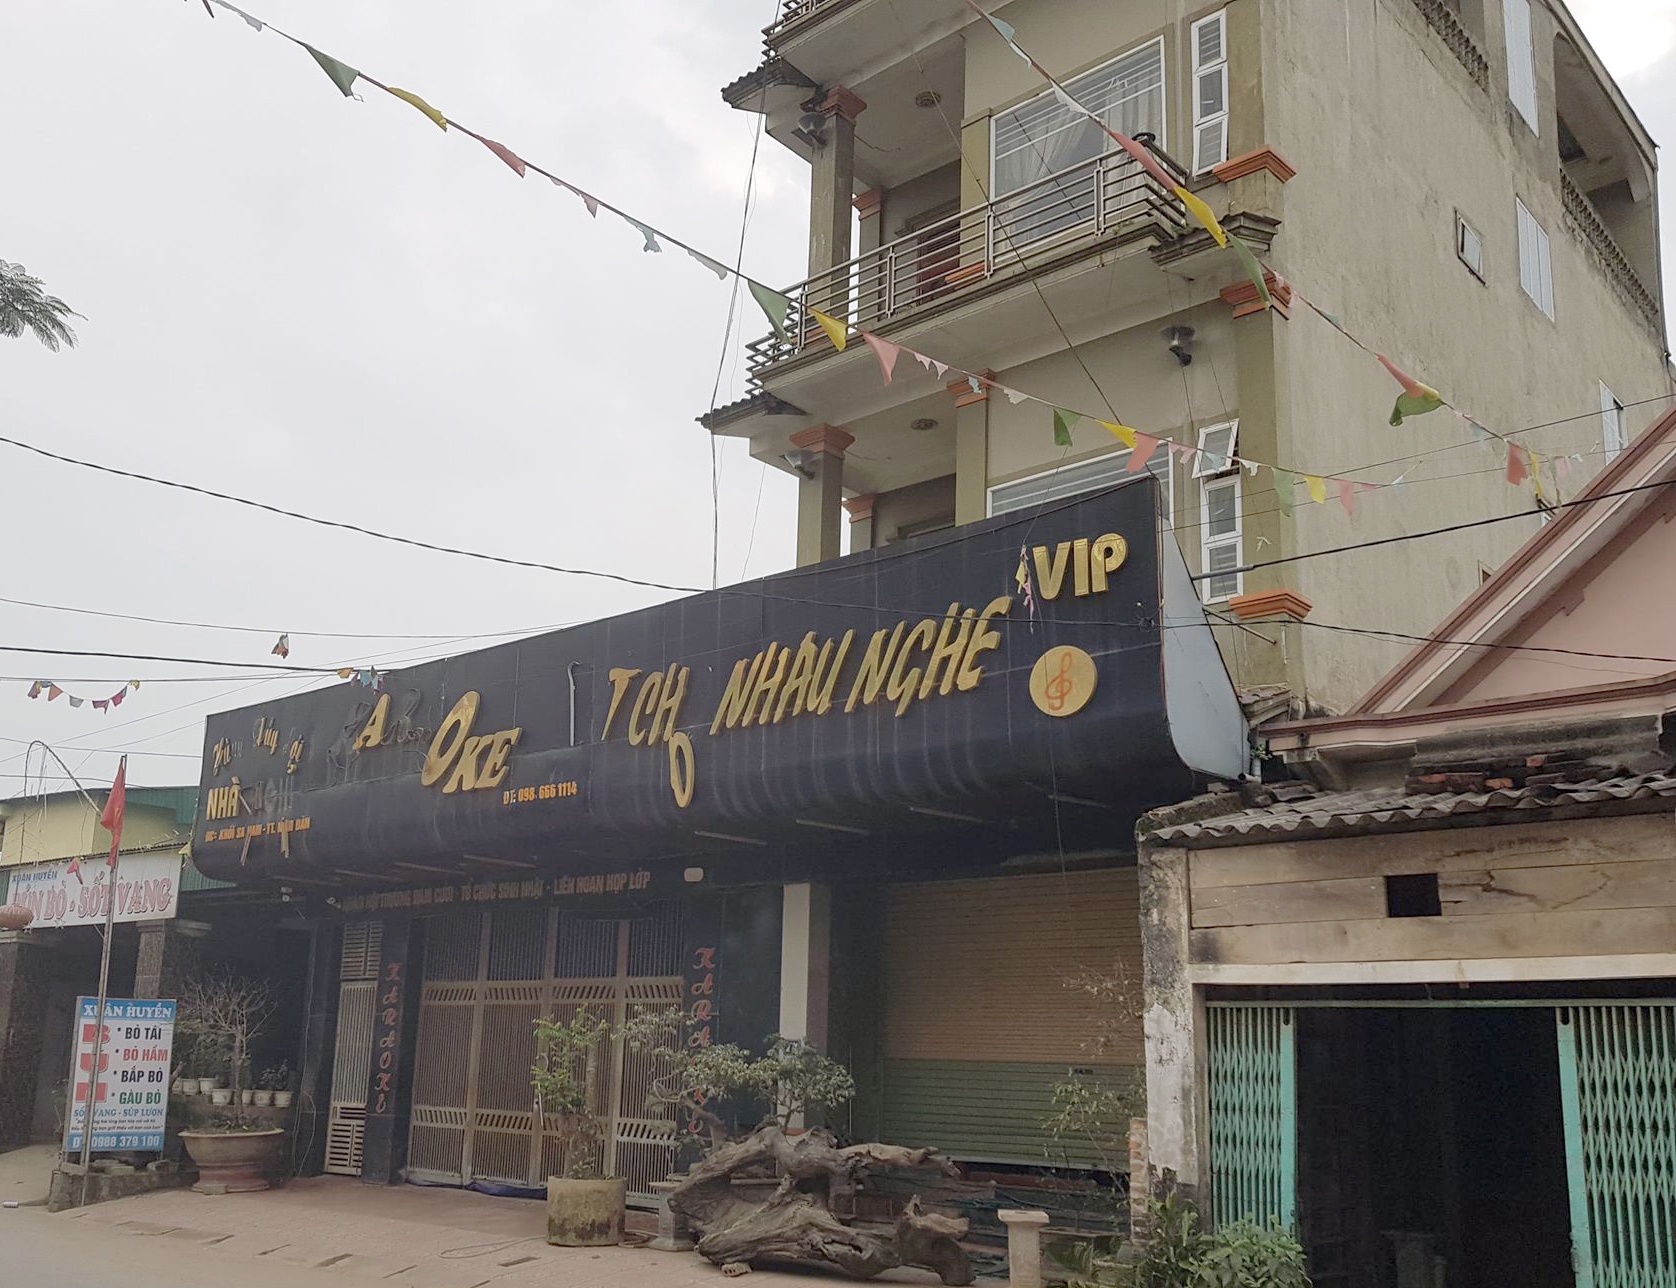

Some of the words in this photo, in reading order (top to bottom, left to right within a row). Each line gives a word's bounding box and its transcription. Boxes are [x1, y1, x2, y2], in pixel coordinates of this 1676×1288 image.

[1032, 533, 1130, 600] VIP
[538, 784, 557, 799] 666
[557, 781, 578, 797] 1114
[119, 1135, 139, 1147] 379
[142, 1135, 160, 1147] 100
